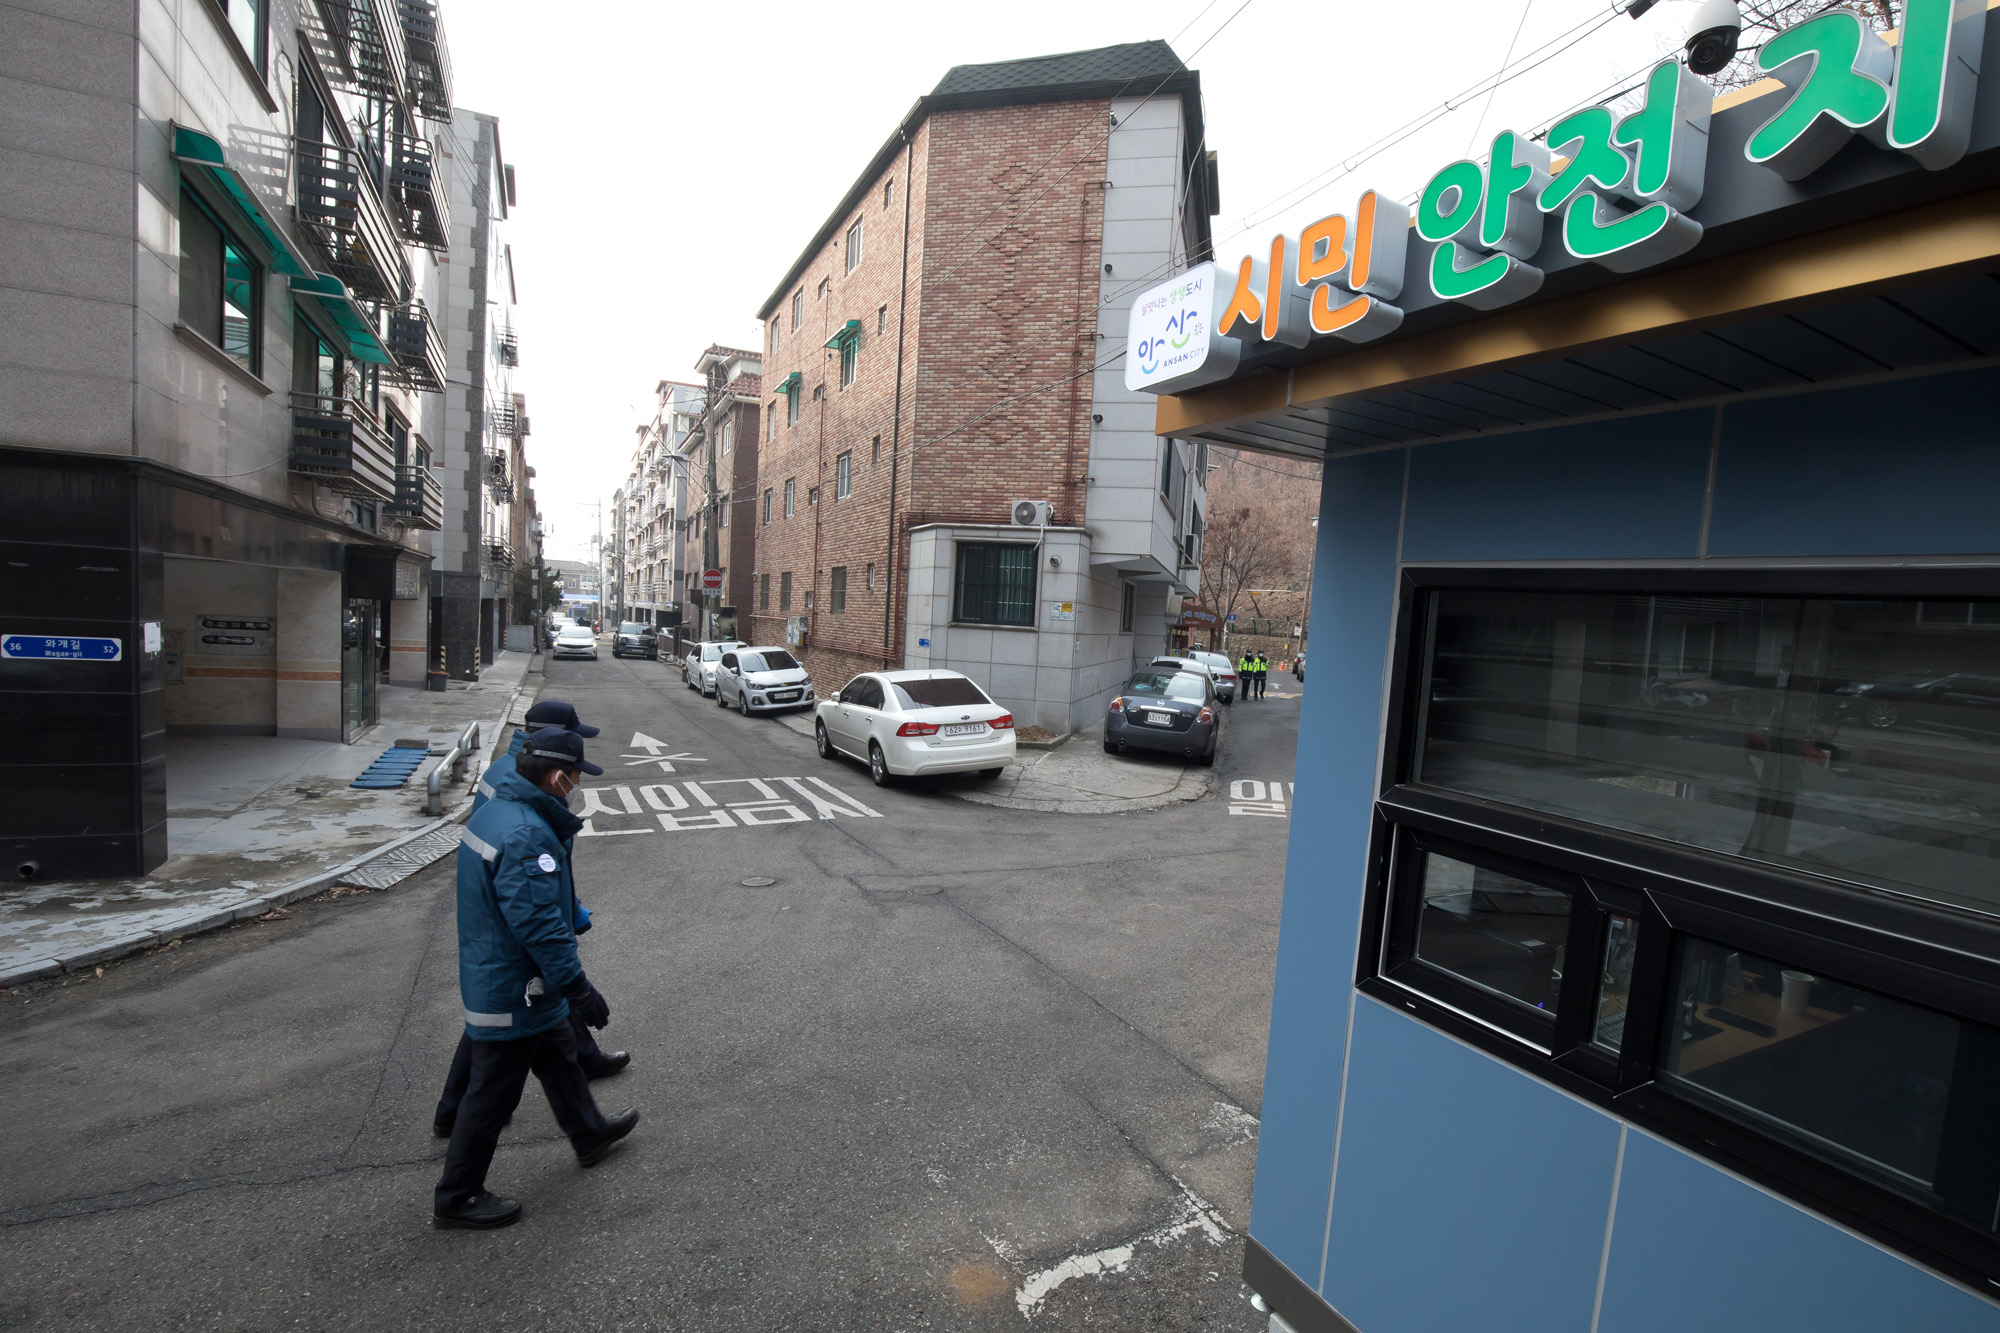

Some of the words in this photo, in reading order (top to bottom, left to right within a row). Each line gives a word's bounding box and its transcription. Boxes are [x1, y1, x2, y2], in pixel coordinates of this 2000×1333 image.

[1217, 188, 1378, 341] 시민
[1415, 58, 1683, 299] 안전
[1744, 0, 1952, 164] 지
[1162, 352, 1189, 368] ANSAN
[1189, 346, 1206, 358] CITY
[9, 642, 22, 651] 36
[45, 639, 81, 650] 와개길
[102, 645, 114, 654] 32
[44, 650, 83, 658] Wagae-gil
[964, 724, 981, 732] 9161
[1227, 779, 1294, 818] 일
[577, 776, 885, 837] 진입금지
